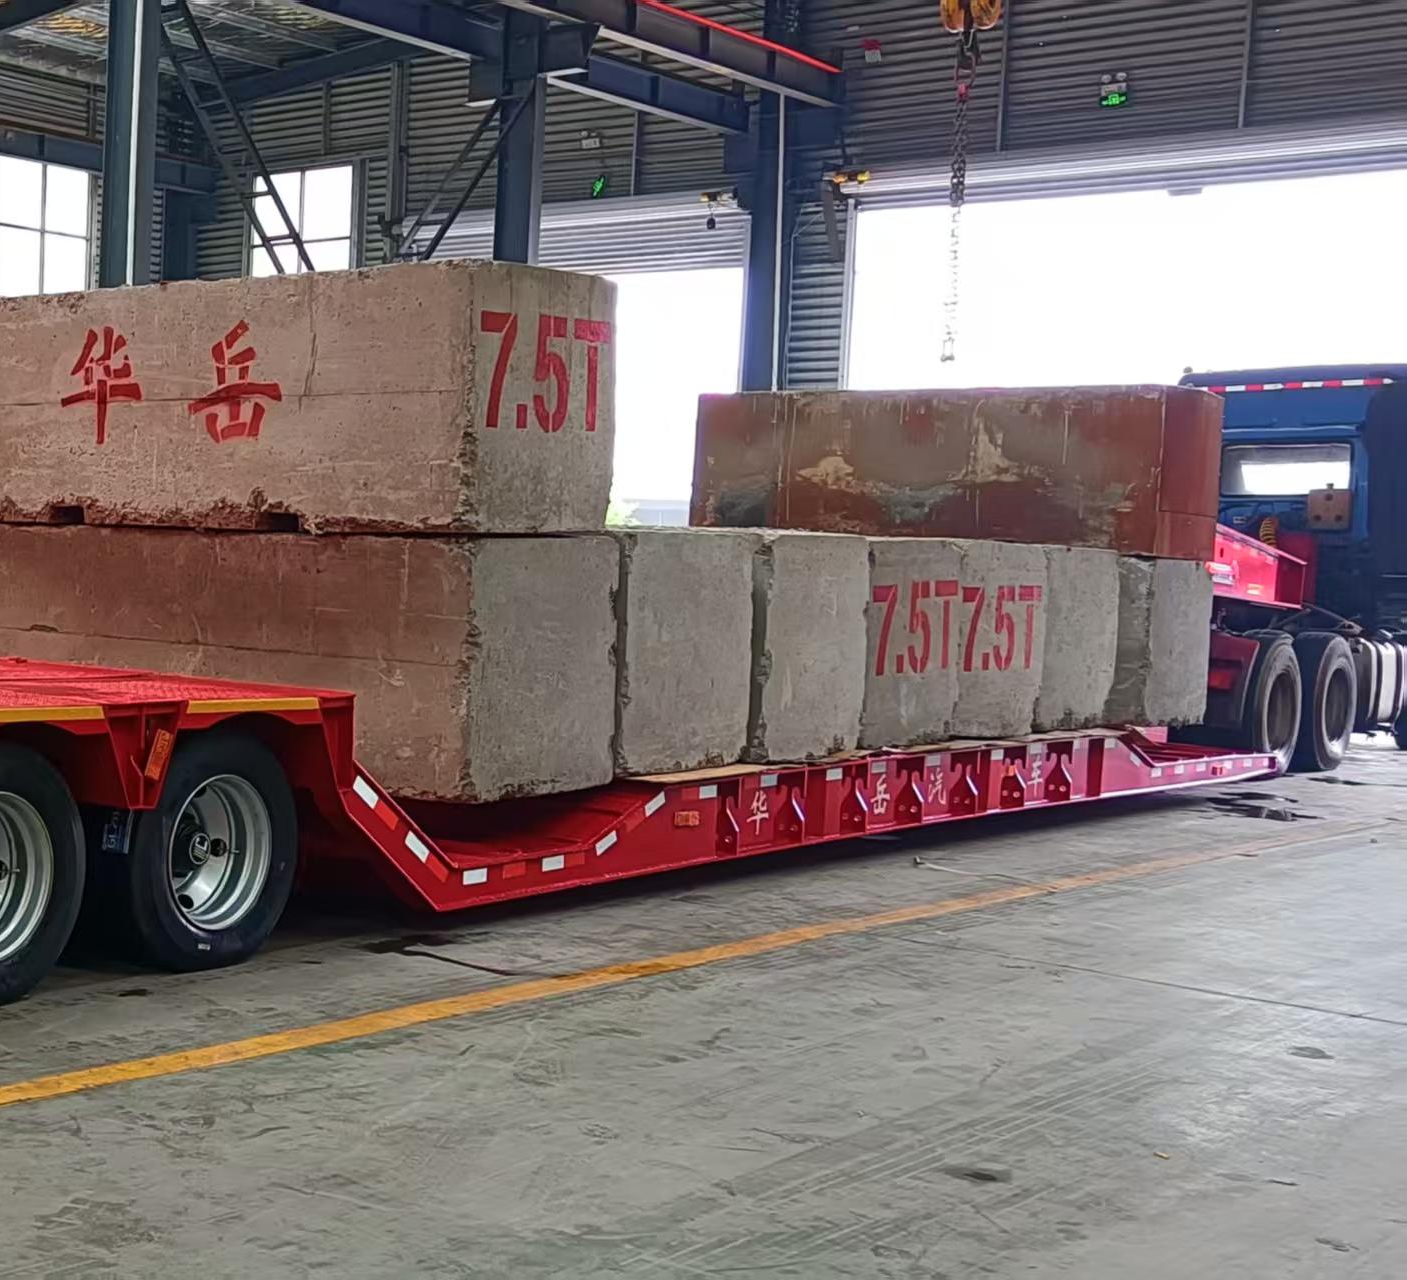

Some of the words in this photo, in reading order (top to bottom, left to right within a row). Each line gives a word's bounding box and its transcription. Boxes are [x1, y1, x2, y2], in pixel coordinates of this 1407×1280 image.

[61, 320, 282, 445] 华岳
[480, 310, 611, 433] 7.5T
[872, 580, 959, 676] 7.5T
[961, 585, 1042, 672] 7.5T
[746, 754, 1044, 836] 华岳汽车
